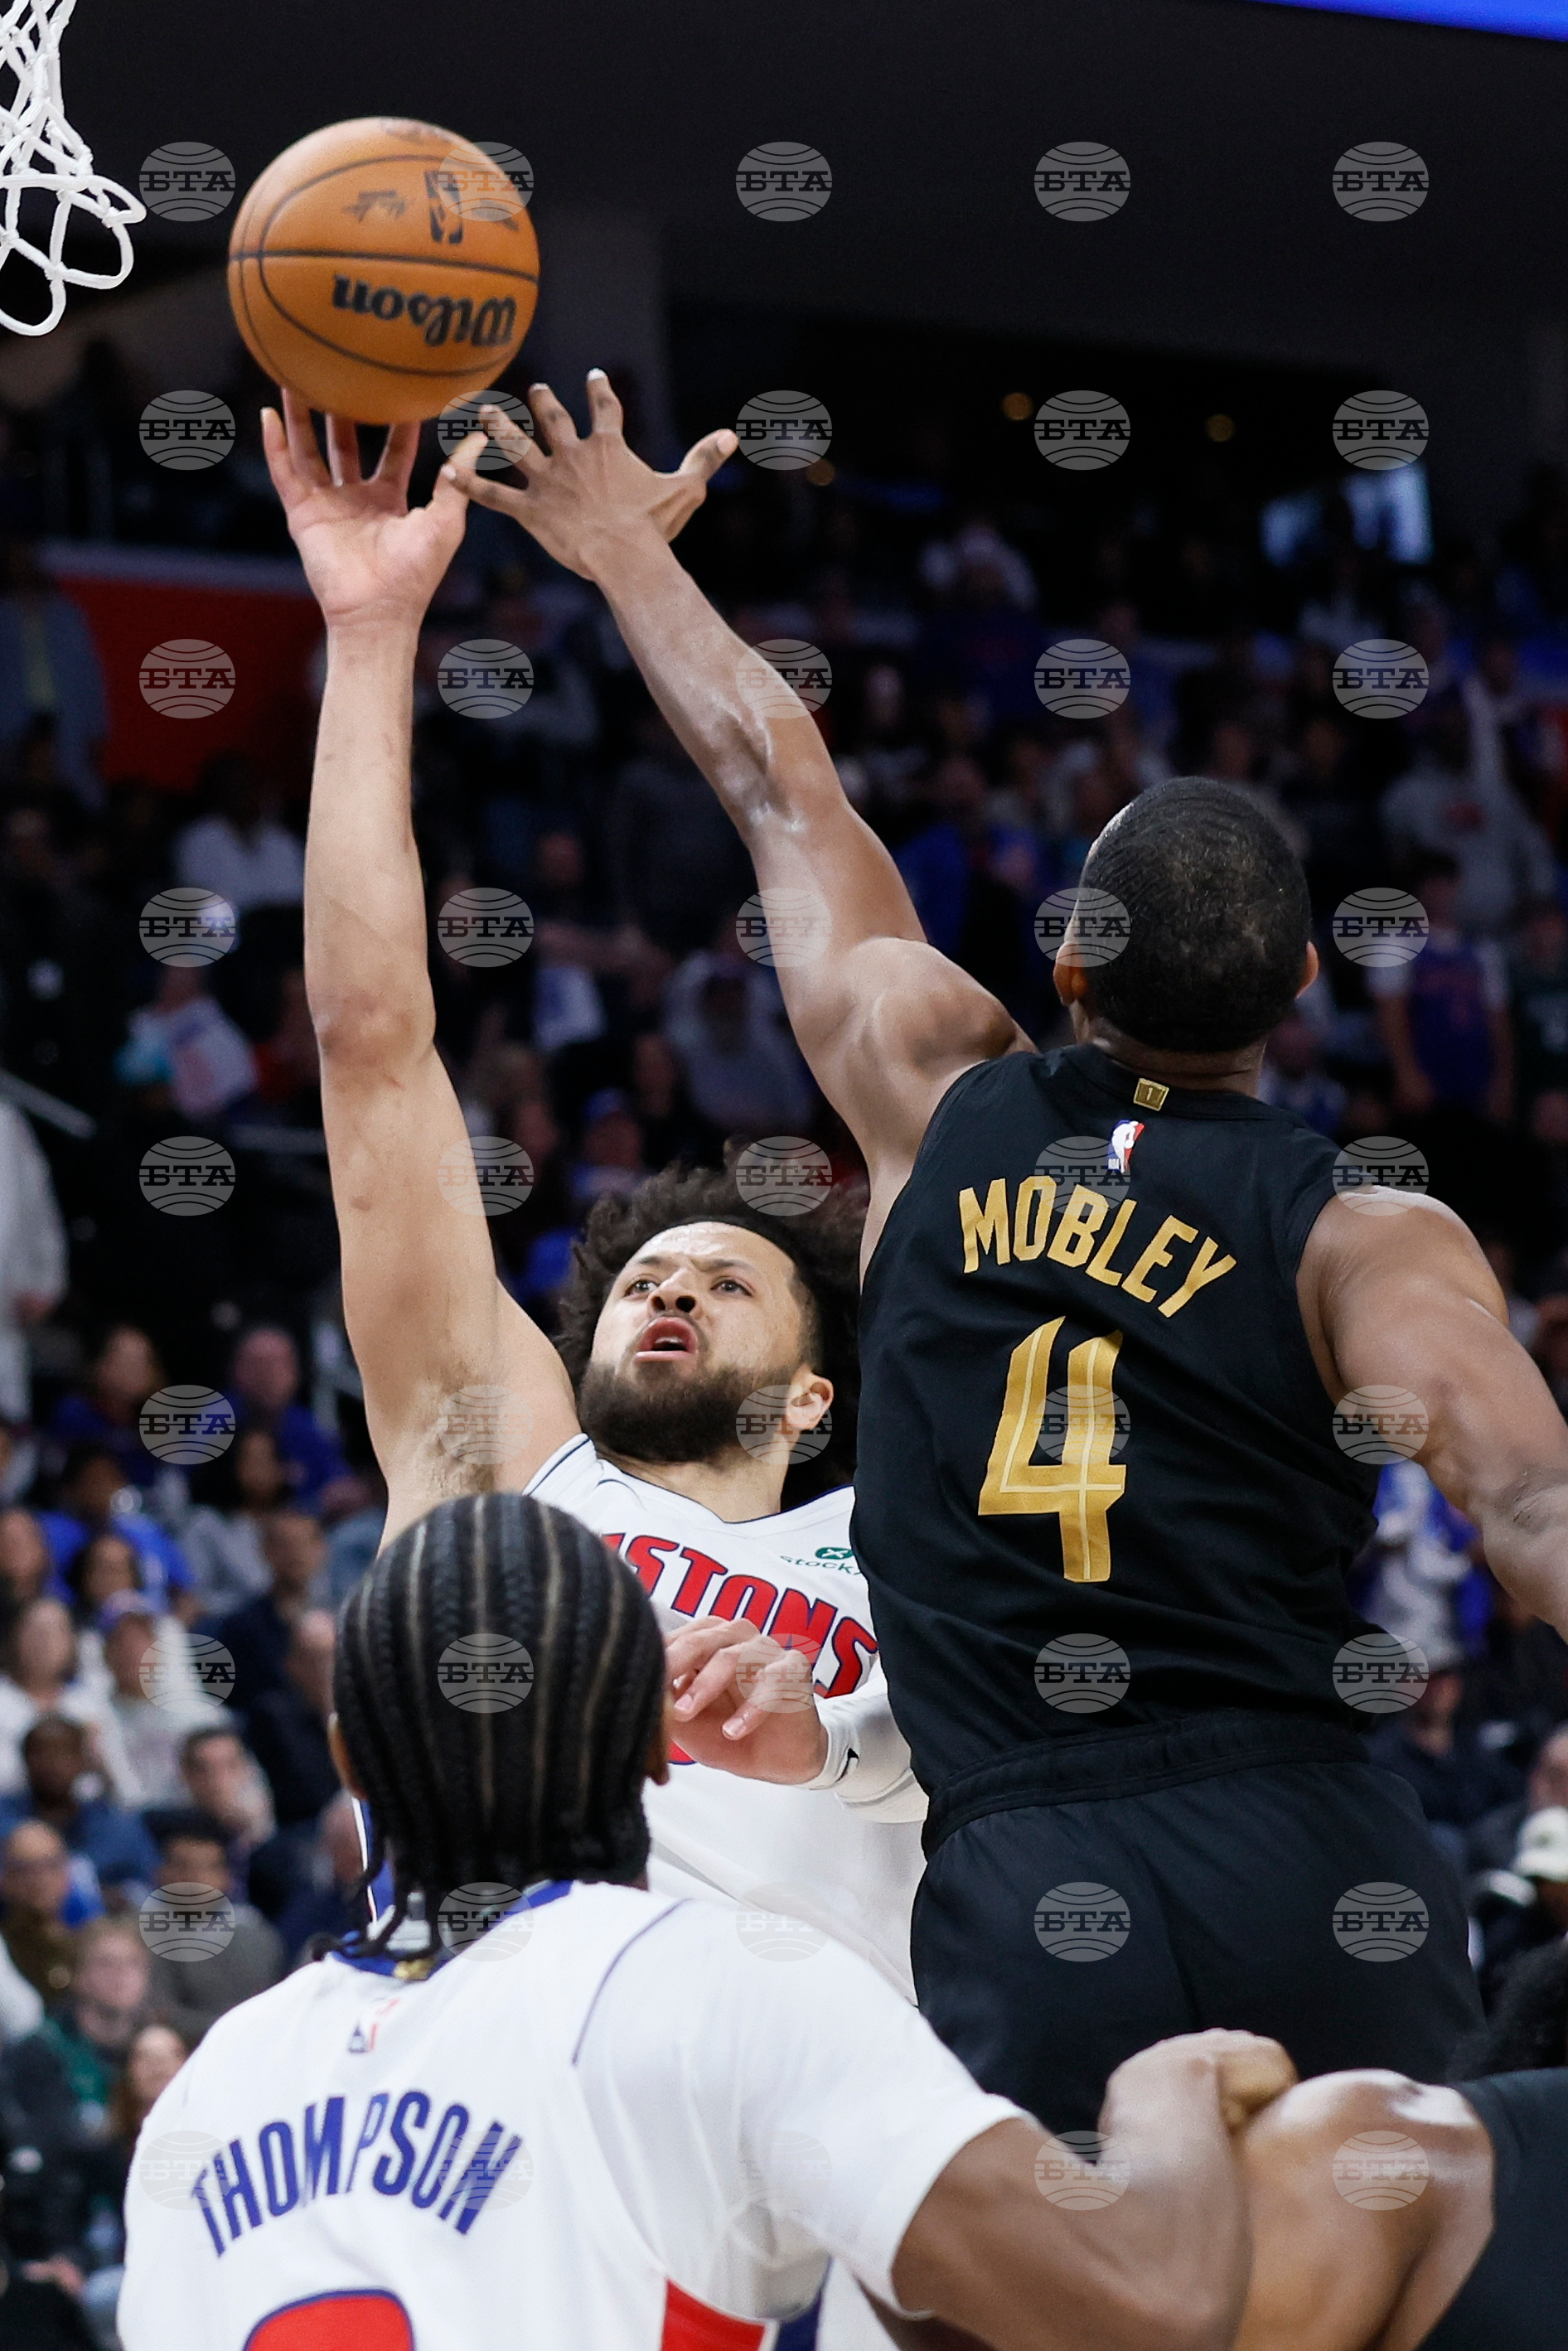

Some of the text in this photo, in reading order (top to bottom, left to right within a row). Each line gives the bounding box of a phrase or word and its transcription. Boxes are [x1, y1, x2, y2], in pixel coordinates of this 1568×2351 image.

[332, 273, 518, 347] Wilson
[959, 1175, 1236, 1318] MOBLEY
[978, 1316, 1126, 1582] 4
[603, 1532, 879, 1699] STONS
[190, 2091, 523, 2259] THOMPSON
